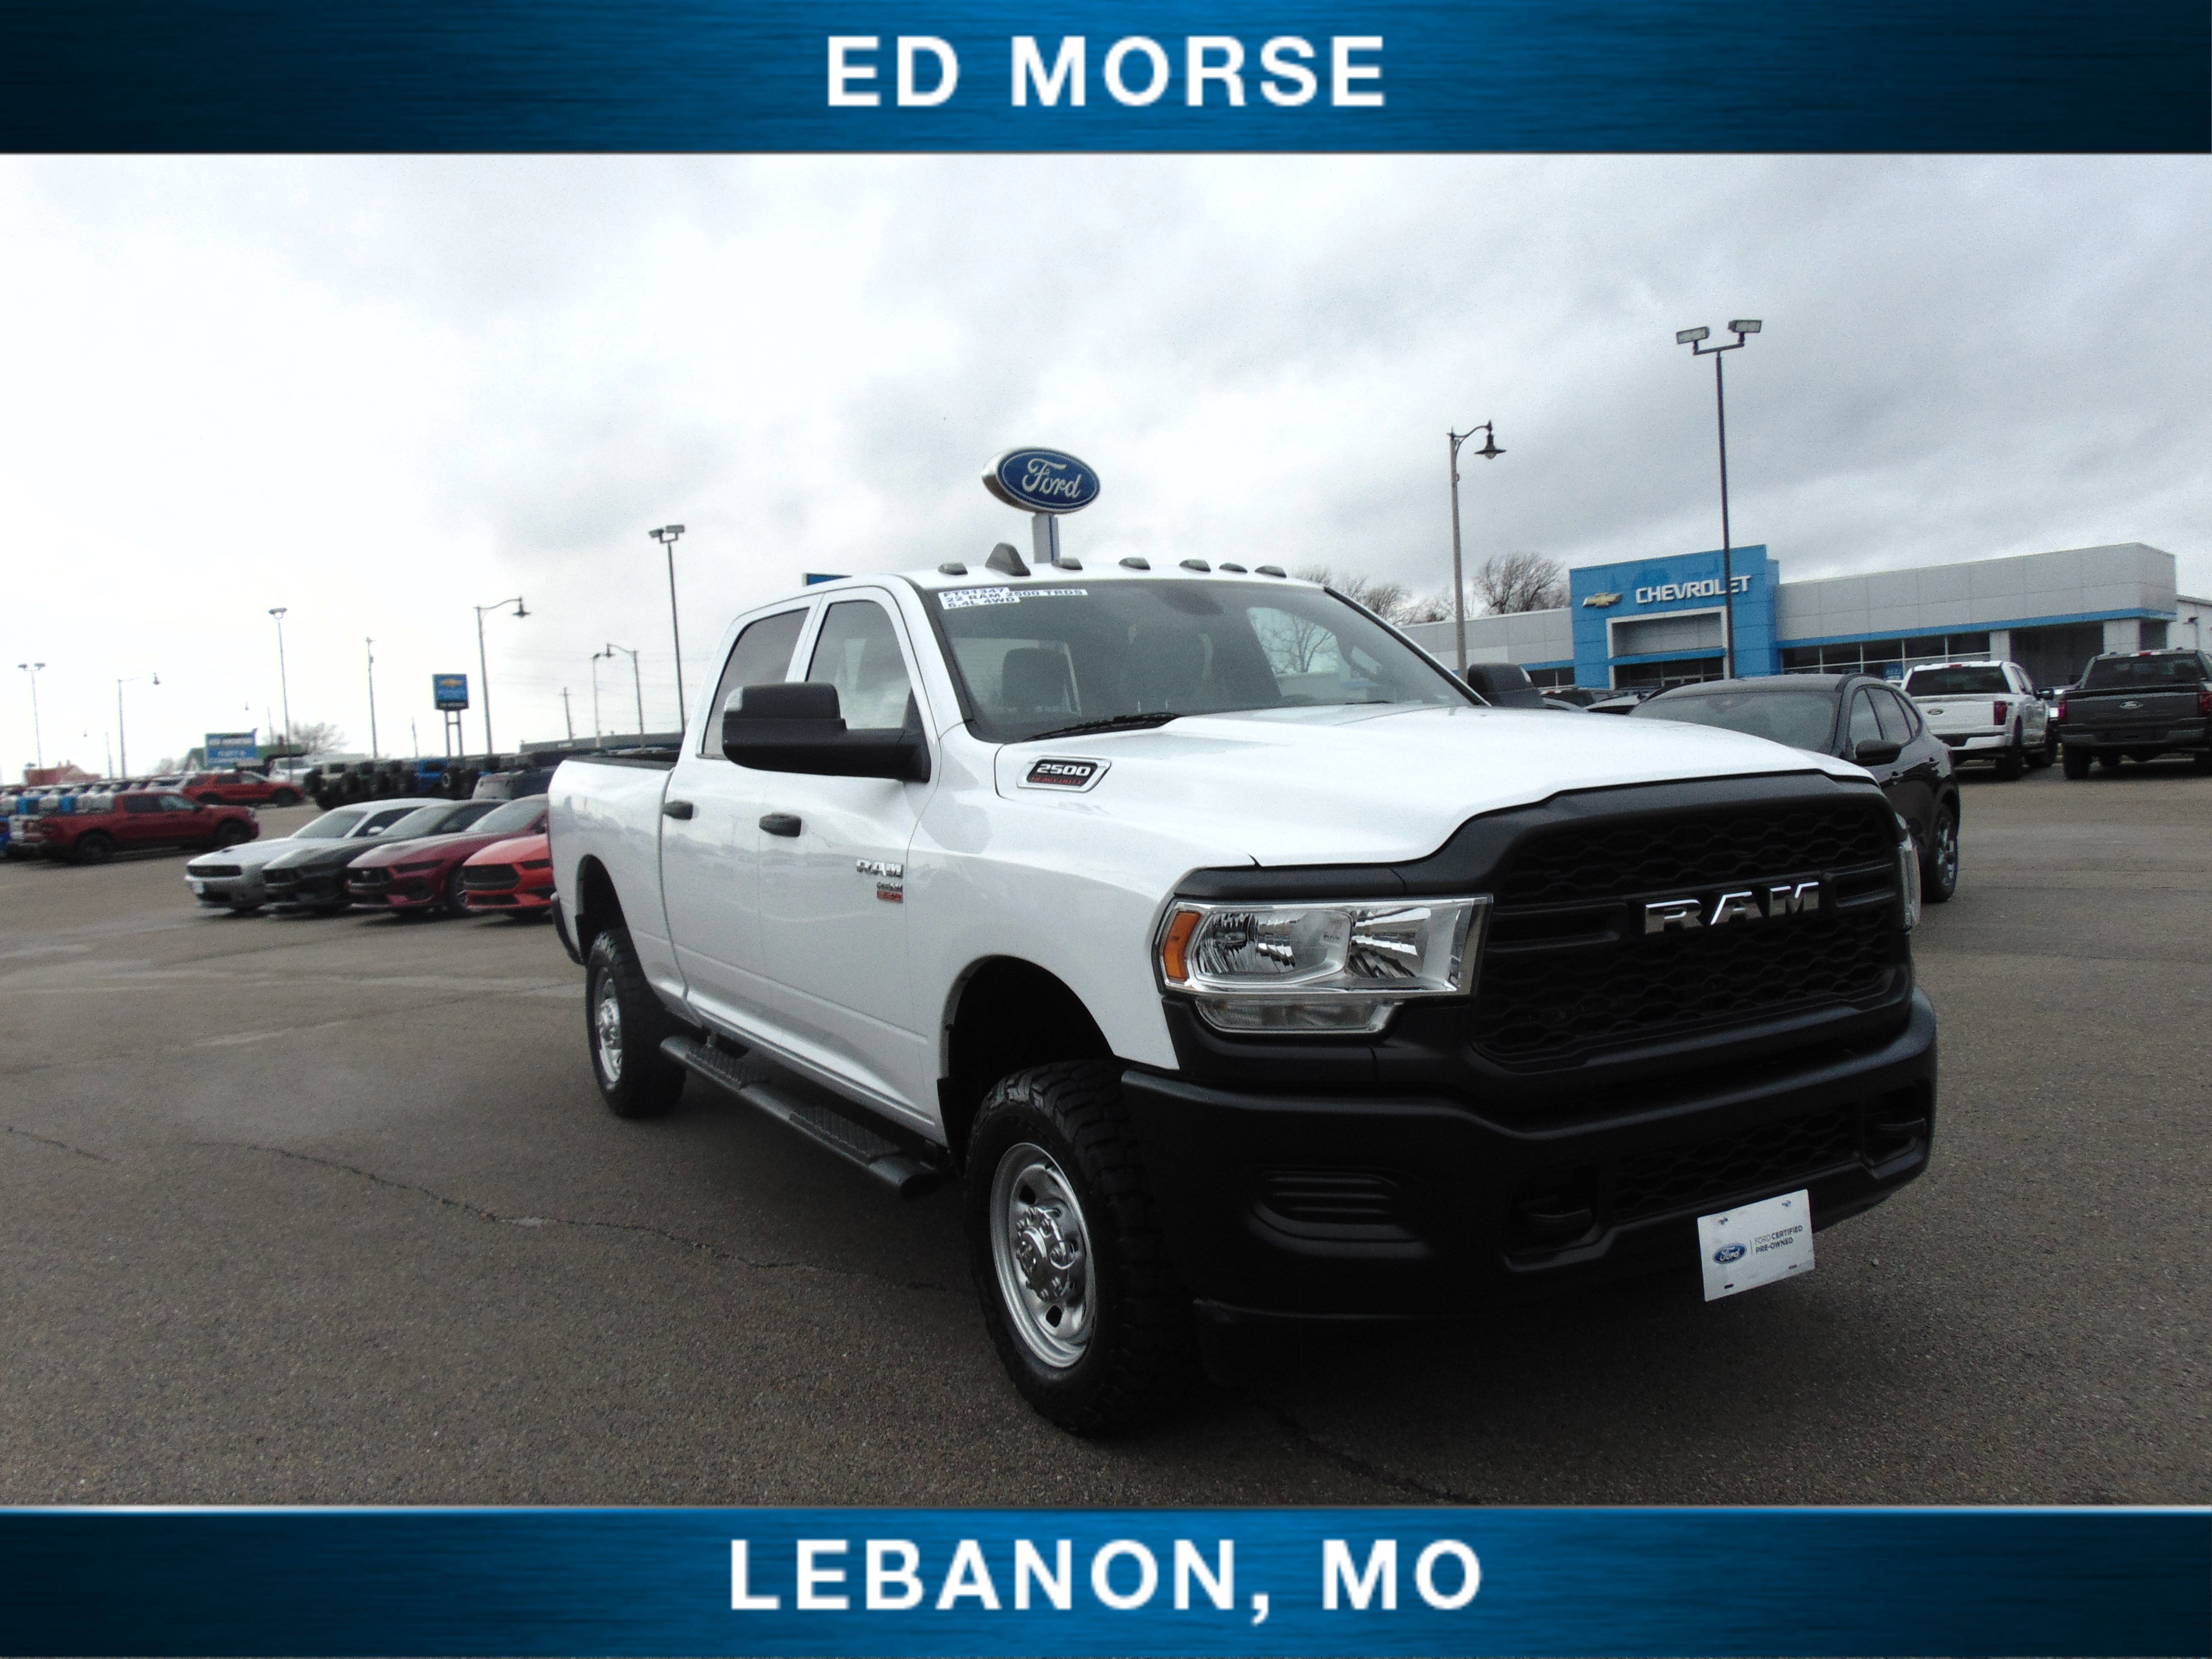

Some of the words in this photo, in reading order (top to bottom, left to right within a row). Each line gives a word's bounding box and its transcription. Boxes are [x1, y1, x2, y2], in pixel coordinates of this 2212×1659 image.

[1022, 458, 1082, 498] Ford
[1636, 575, 1752, 604] CHEVROLET
[1036, 763, 1091, 776] 2500
[1645, 881, 1819, 935] RAM
[1755, 1237, 1793, 1254] PRE-OWNED
